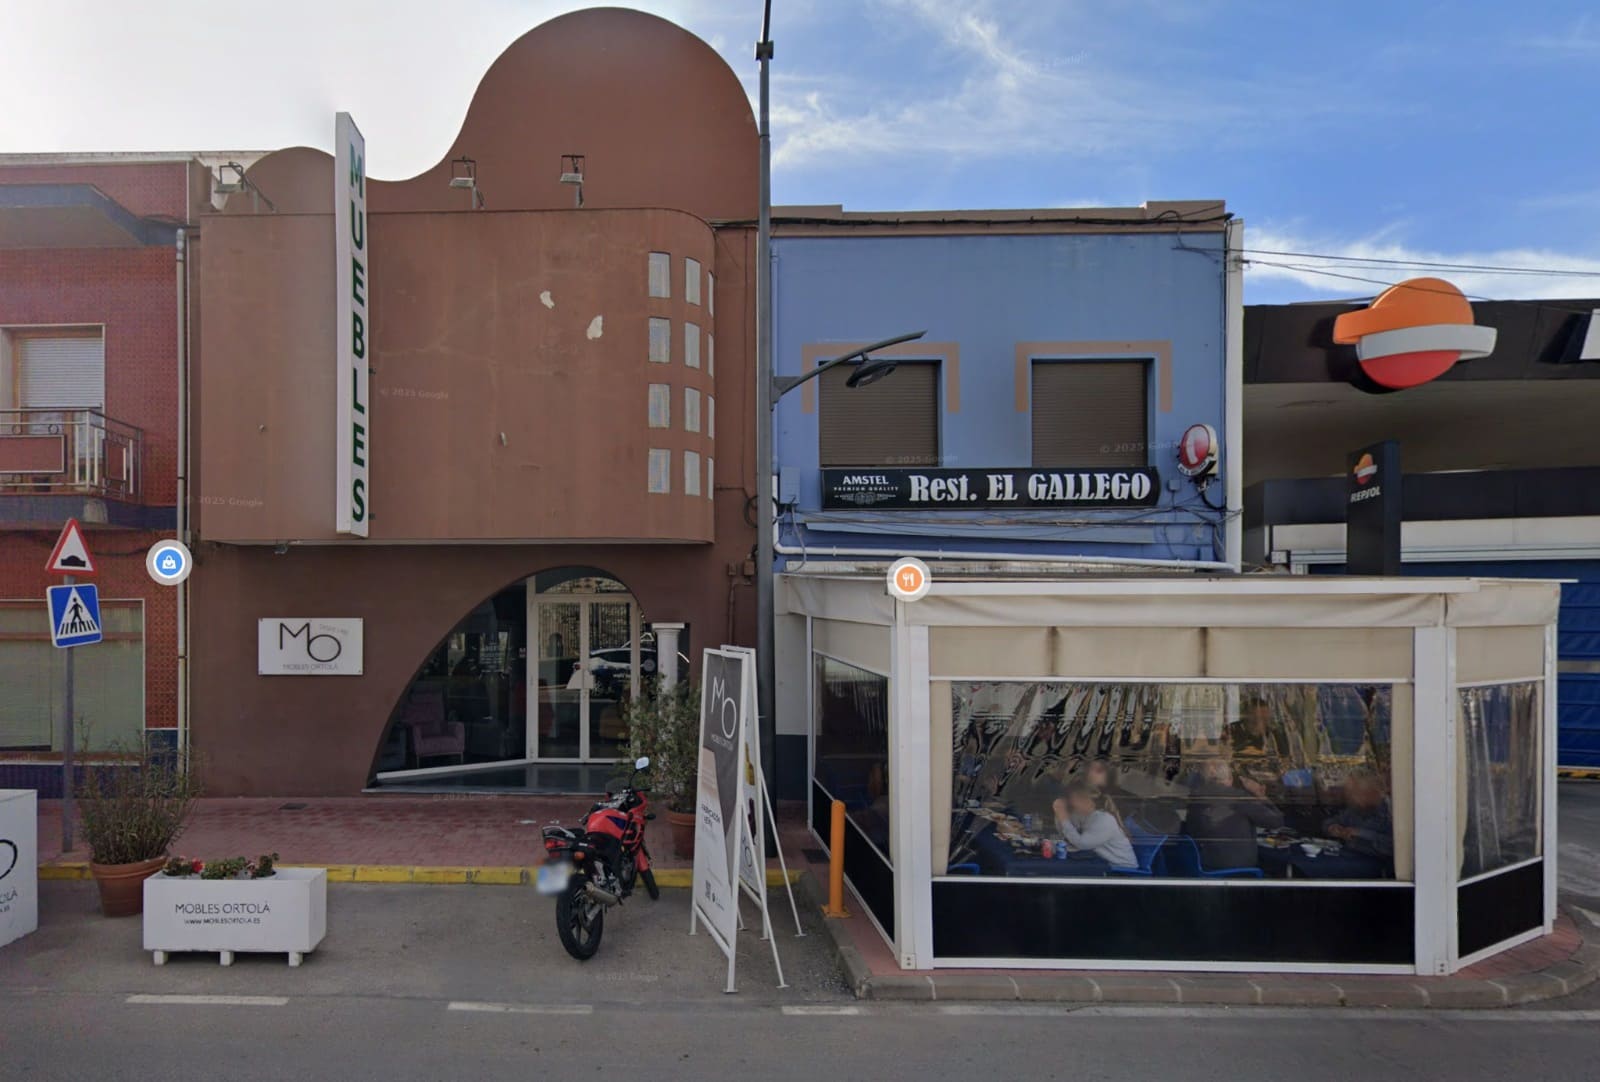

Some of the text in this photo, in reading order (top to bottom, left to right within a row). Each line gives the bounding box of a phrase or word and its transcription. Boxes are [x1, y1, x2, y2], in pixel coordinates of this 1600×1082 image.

[350, 143, 365, 522] MUEBLES
[842, 475, 889, 485] AMSTEL
[908, 474, 977, 502] Rest.
[986, 474, 1019, 501] EL
[1027, 472, 1151, 501] GALLEGO
[1350, 486, 1381, 502] REPSOL
[279, 622, 342, 663] MO
[711, 675, 737, 739] MO
[175, 904, 220, 914] MOBLES
